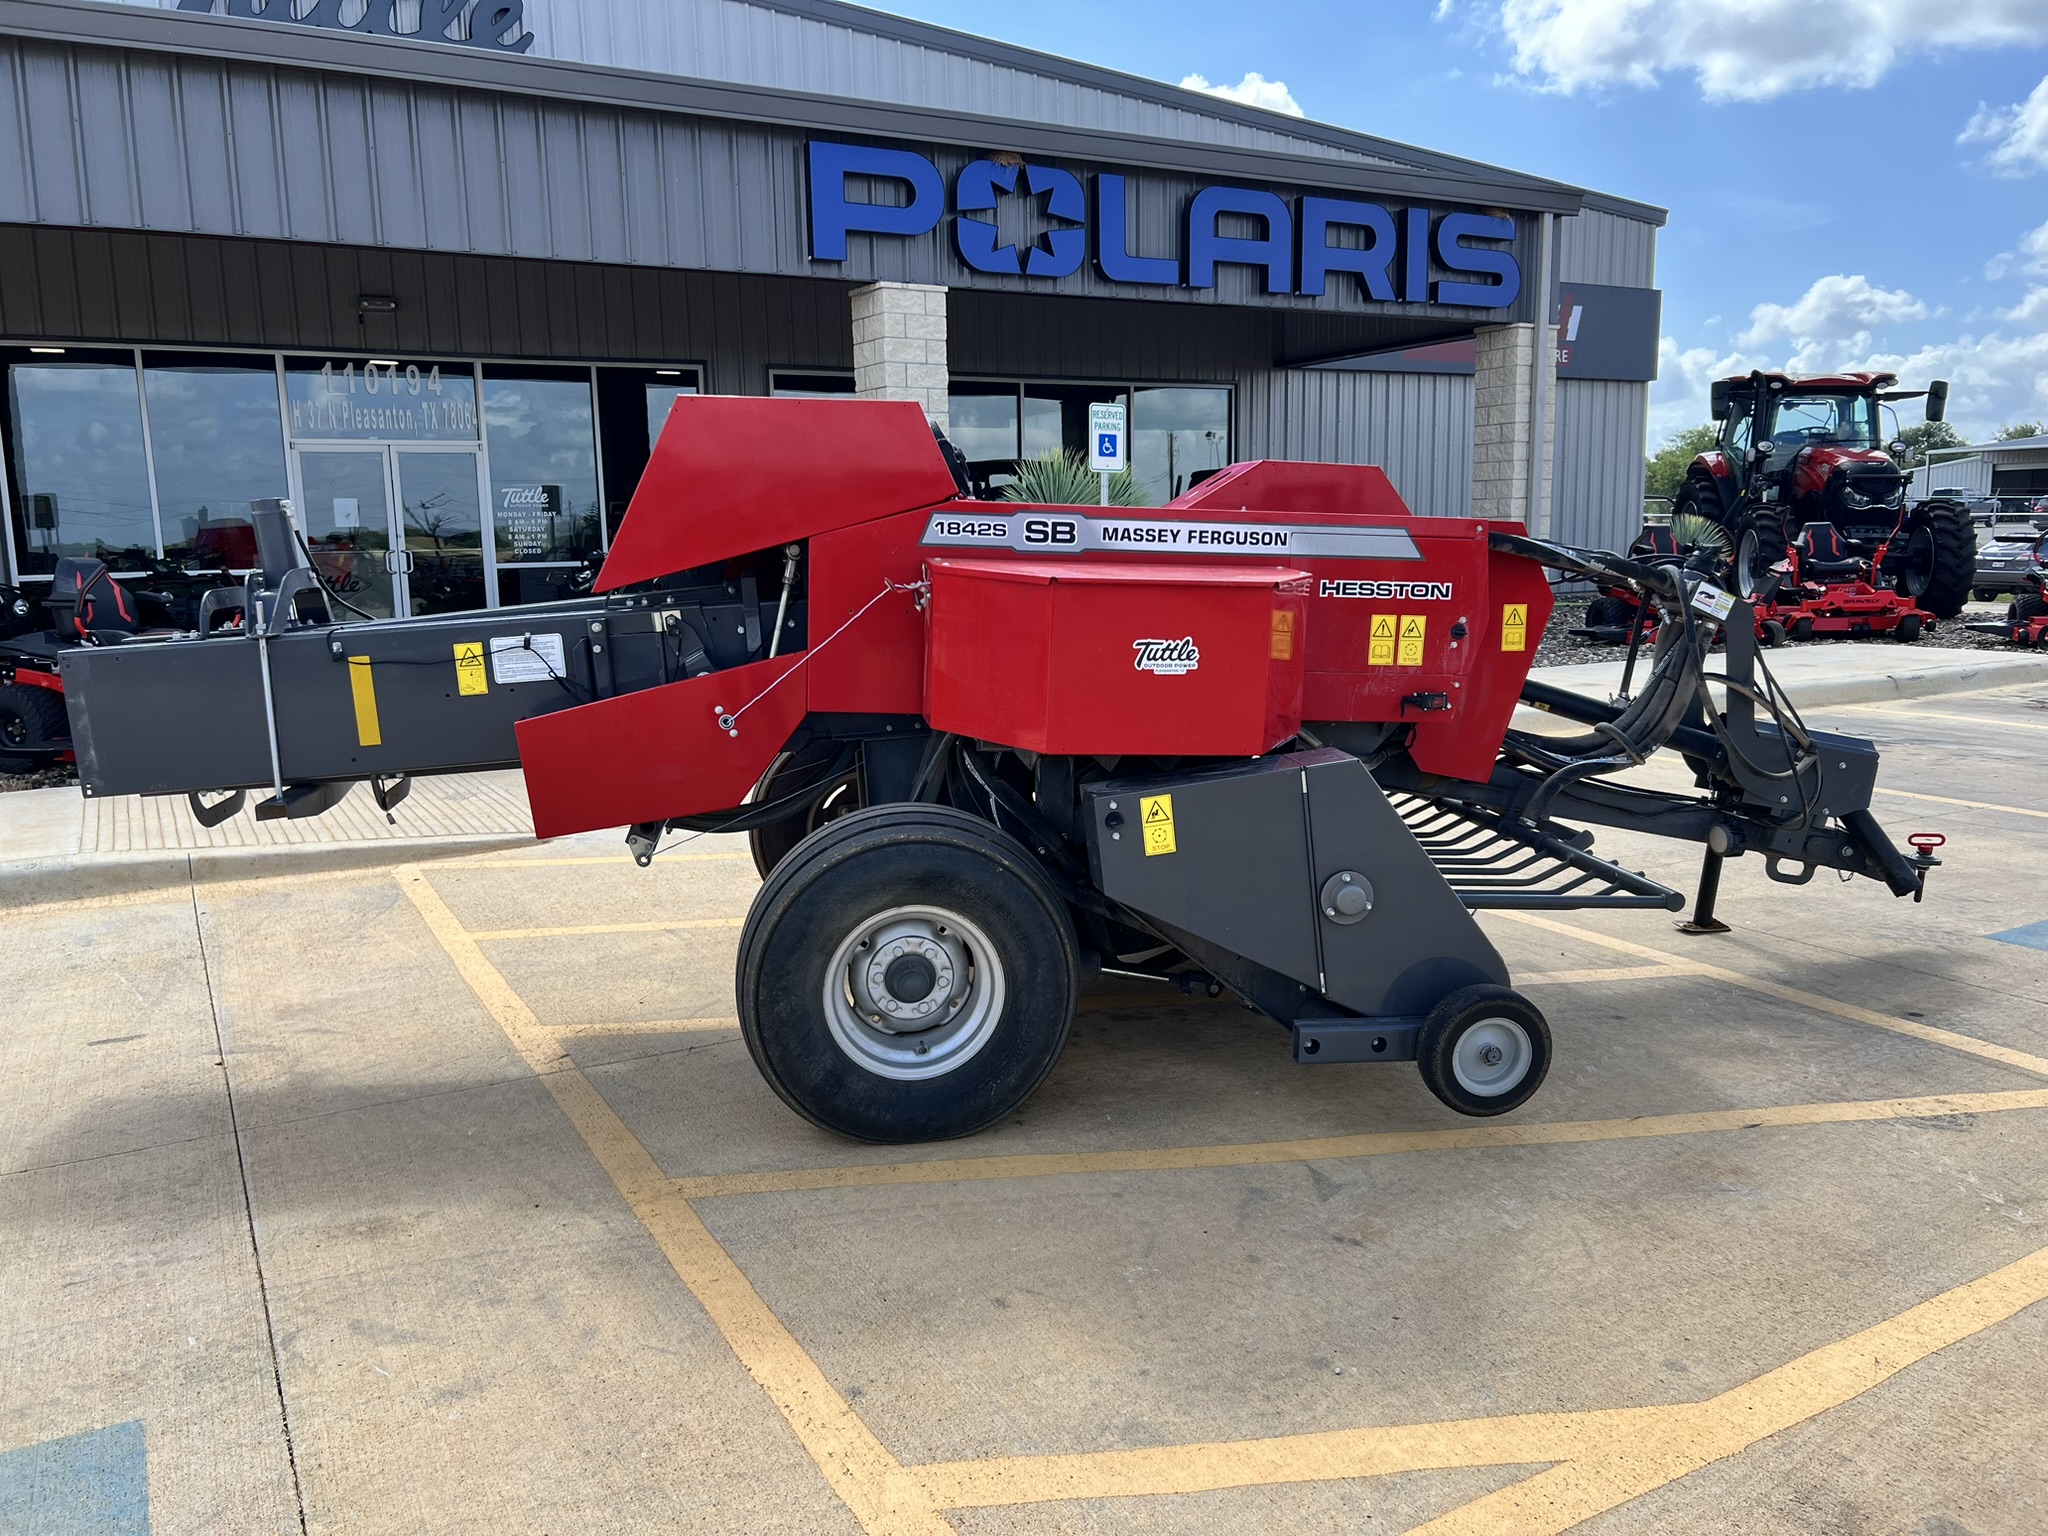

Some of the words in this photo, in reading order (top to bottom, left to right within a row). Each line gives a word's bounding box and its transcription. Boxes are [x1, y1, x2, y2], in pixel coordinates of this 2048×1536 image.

[807, 140, 1521, 309] POLARIS
[321, 361, 443, 396] 110194
[308, 400, 321, 430] 37
[329, 401, 337, 431] N
[342, 402, 418, 437] Pleasanton,
[422, 402, 439, 431] TX
[1092, 410, 1123, 421] RESERVED
[1094, 421, 1121, 431] PARKING
[501, 486, 550, 508] Tuttle
[933, 520, 1008, 538] 1842S
[1023, 518, 1077, 546] SB
[1101, 526, 1182, 544] MASSEY
[1187, 529, 1289, 547] FERGUSON
[1319, 580, 1452, 600] HESSTON
[1134, 638, 1198, 669] Tuttle
[1151, 843, 1171, 852] STOP
